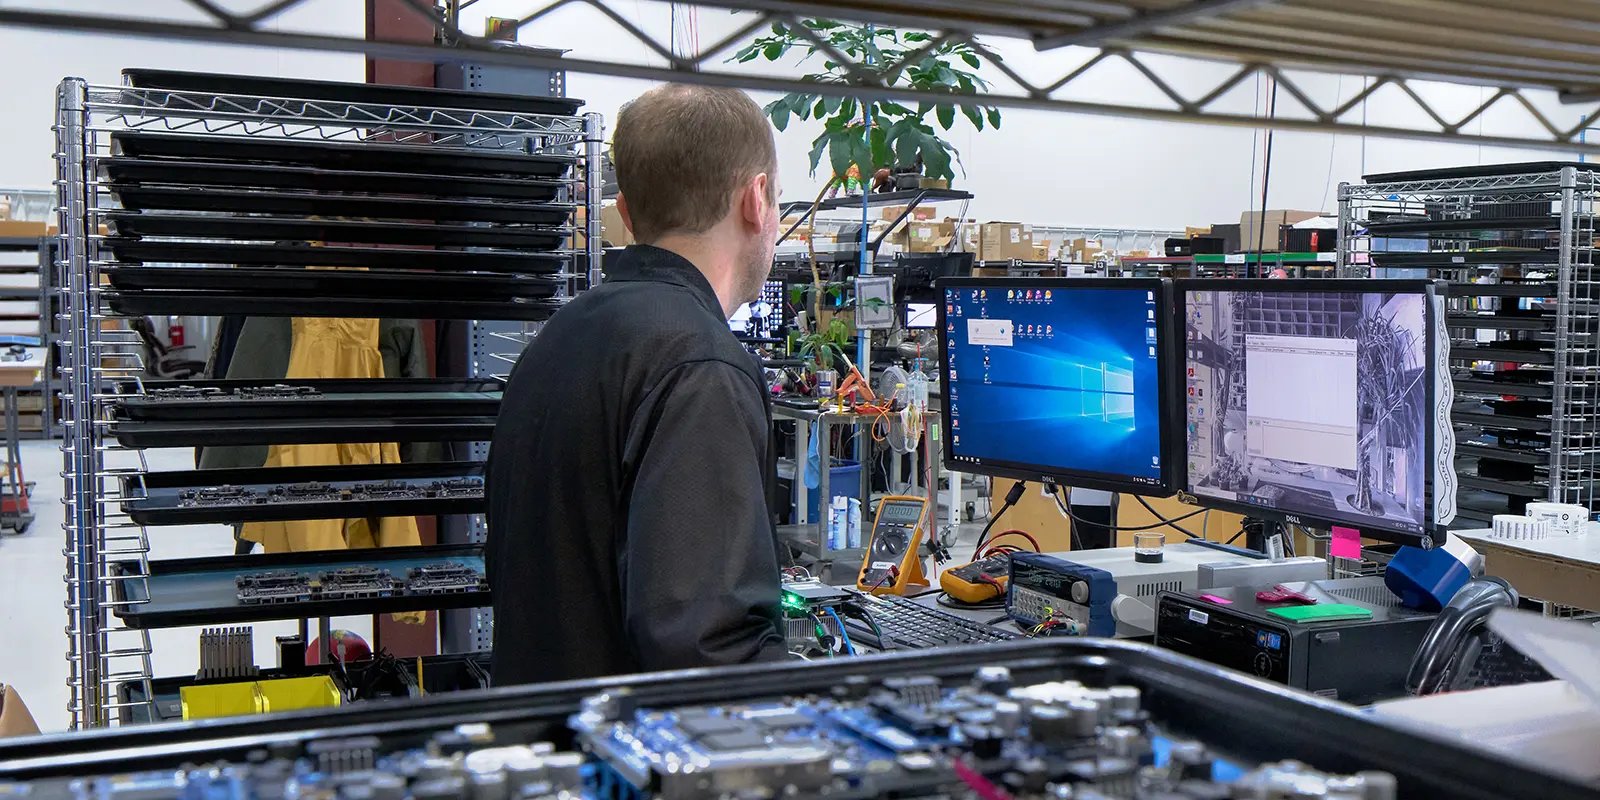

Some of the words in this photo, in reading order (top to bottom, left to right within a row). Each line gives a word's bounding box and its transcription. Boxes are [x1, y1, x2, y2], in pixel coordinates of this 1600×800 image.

[1015, 259, 1023, 267] 12
[1097, 261, 1104, 269] 13
[1041, 475, 1056, 483] DELL
[1285, 514, 1301, 524] DELL
